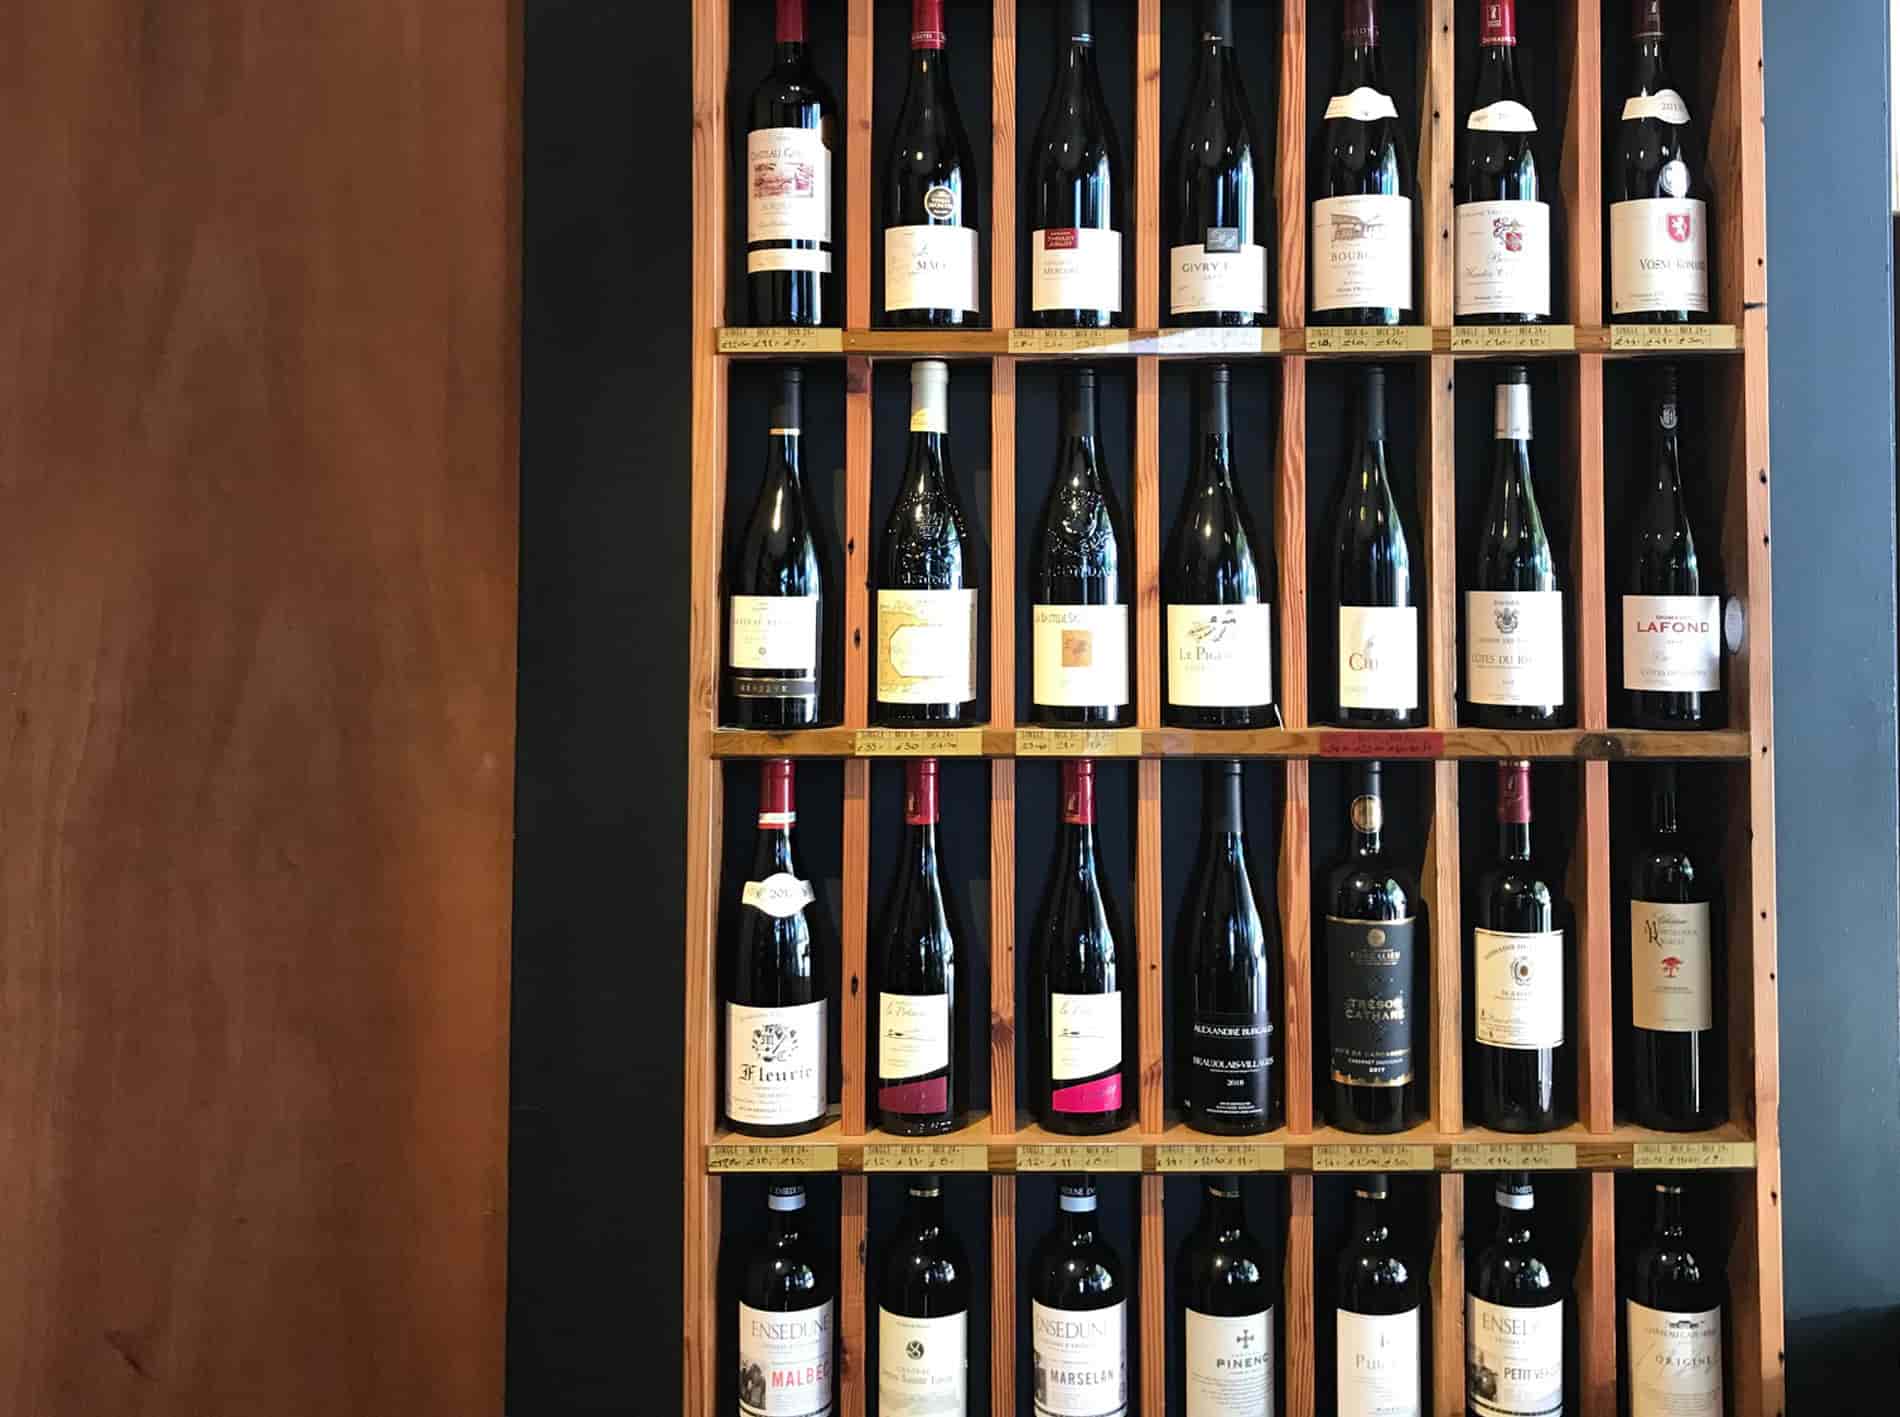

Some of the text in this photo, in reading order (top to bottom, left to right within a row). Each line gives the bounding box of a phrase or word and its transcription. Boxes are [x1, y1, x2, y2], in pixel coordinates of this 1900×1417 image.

[1182, 262, 1217, 273] GIVRY
[1636, 621, 1710, 633] LAFOND
[1194, 1023, 1241, 1037] ALEXANDRE
[740, 1064, 814, 1083] Fleurie
[1050, 1367, 1114, 1387] MARSELAN
[1503, 1366, 1531, 1381] PETIT
